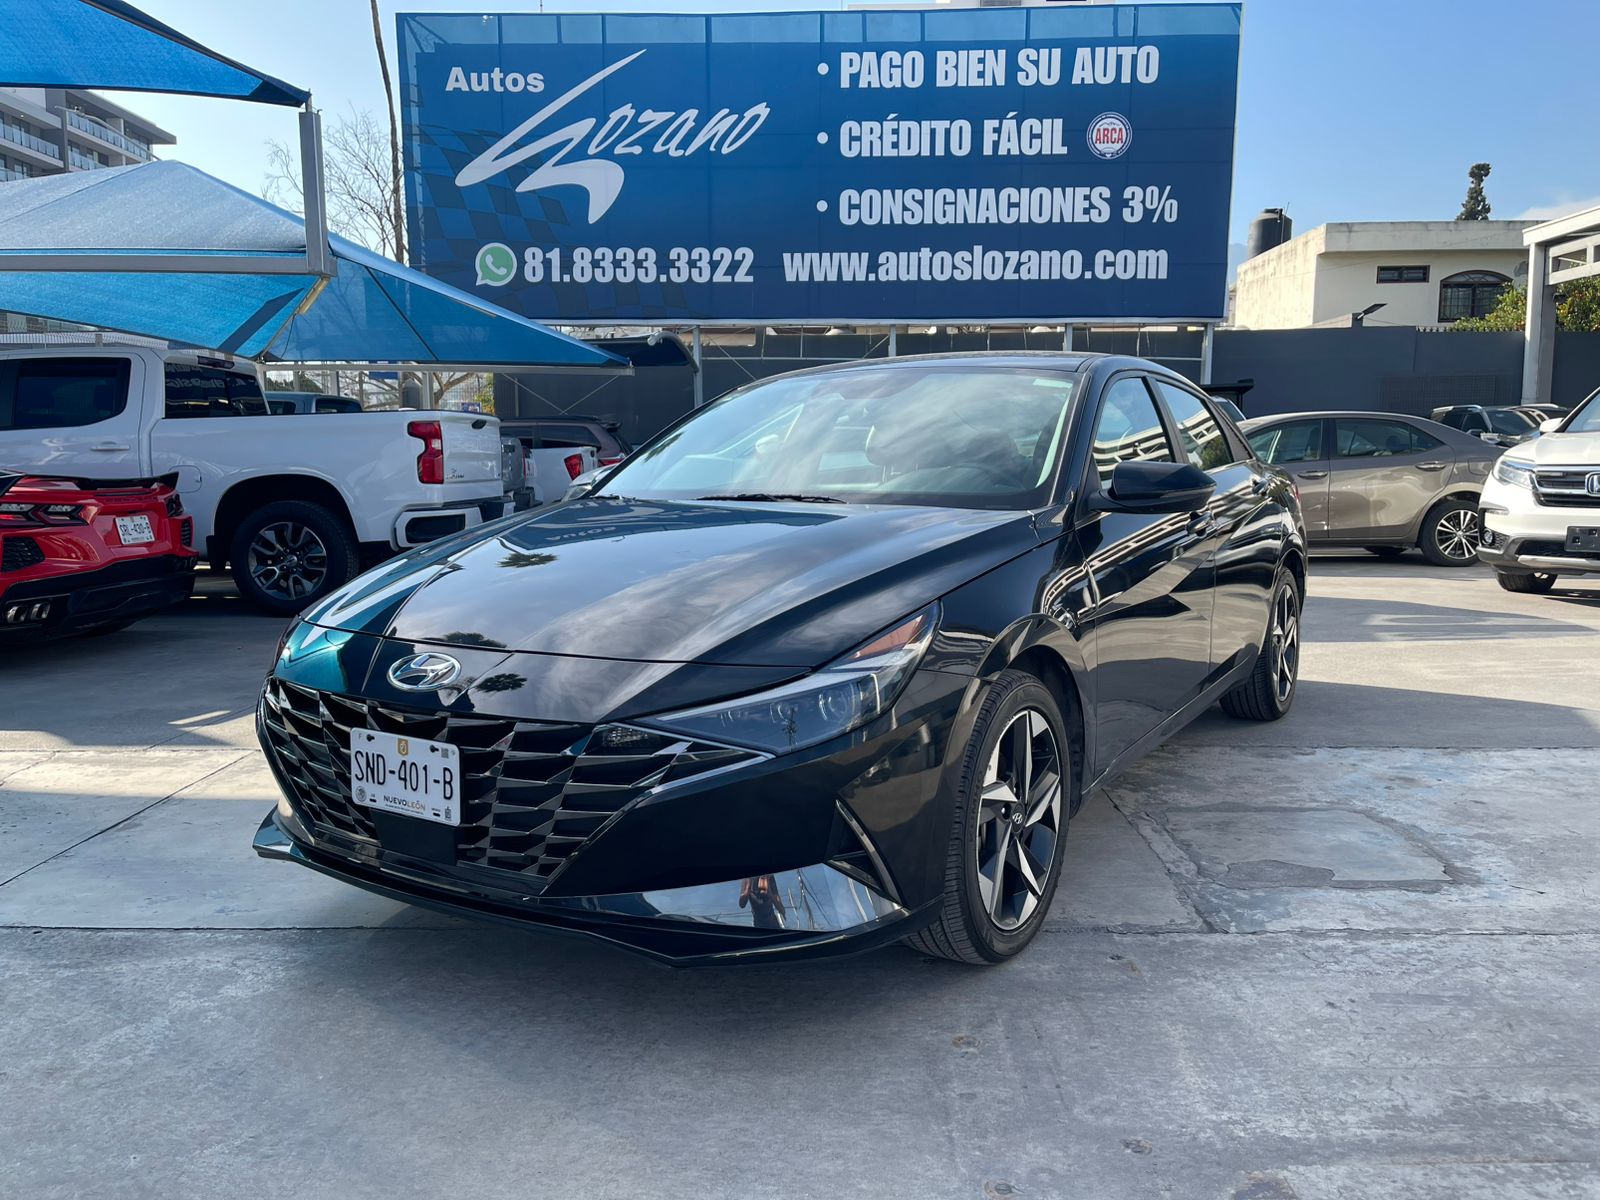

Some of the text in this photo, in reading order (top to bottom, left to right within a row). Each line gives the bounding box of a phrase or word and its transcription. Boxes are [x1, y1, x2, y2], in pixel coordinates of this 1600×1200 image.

[445, 67, 545, 92] Autos
[841, 45, 1160, 88] PAGO BIEN SU AUTO
[840, 112, 1068, 157] CRÉDITO FÁCIL
[1095, 127, 1124, 144] ARCA
[839, 186, 1178, 225] CONSIGNACIONES 3%
[524, 247, 754, 282] 81.8333.3322
[783, 246, 1168, 281] www.autoslozano.com
[354, 750, 454, 800] SND-401-B
